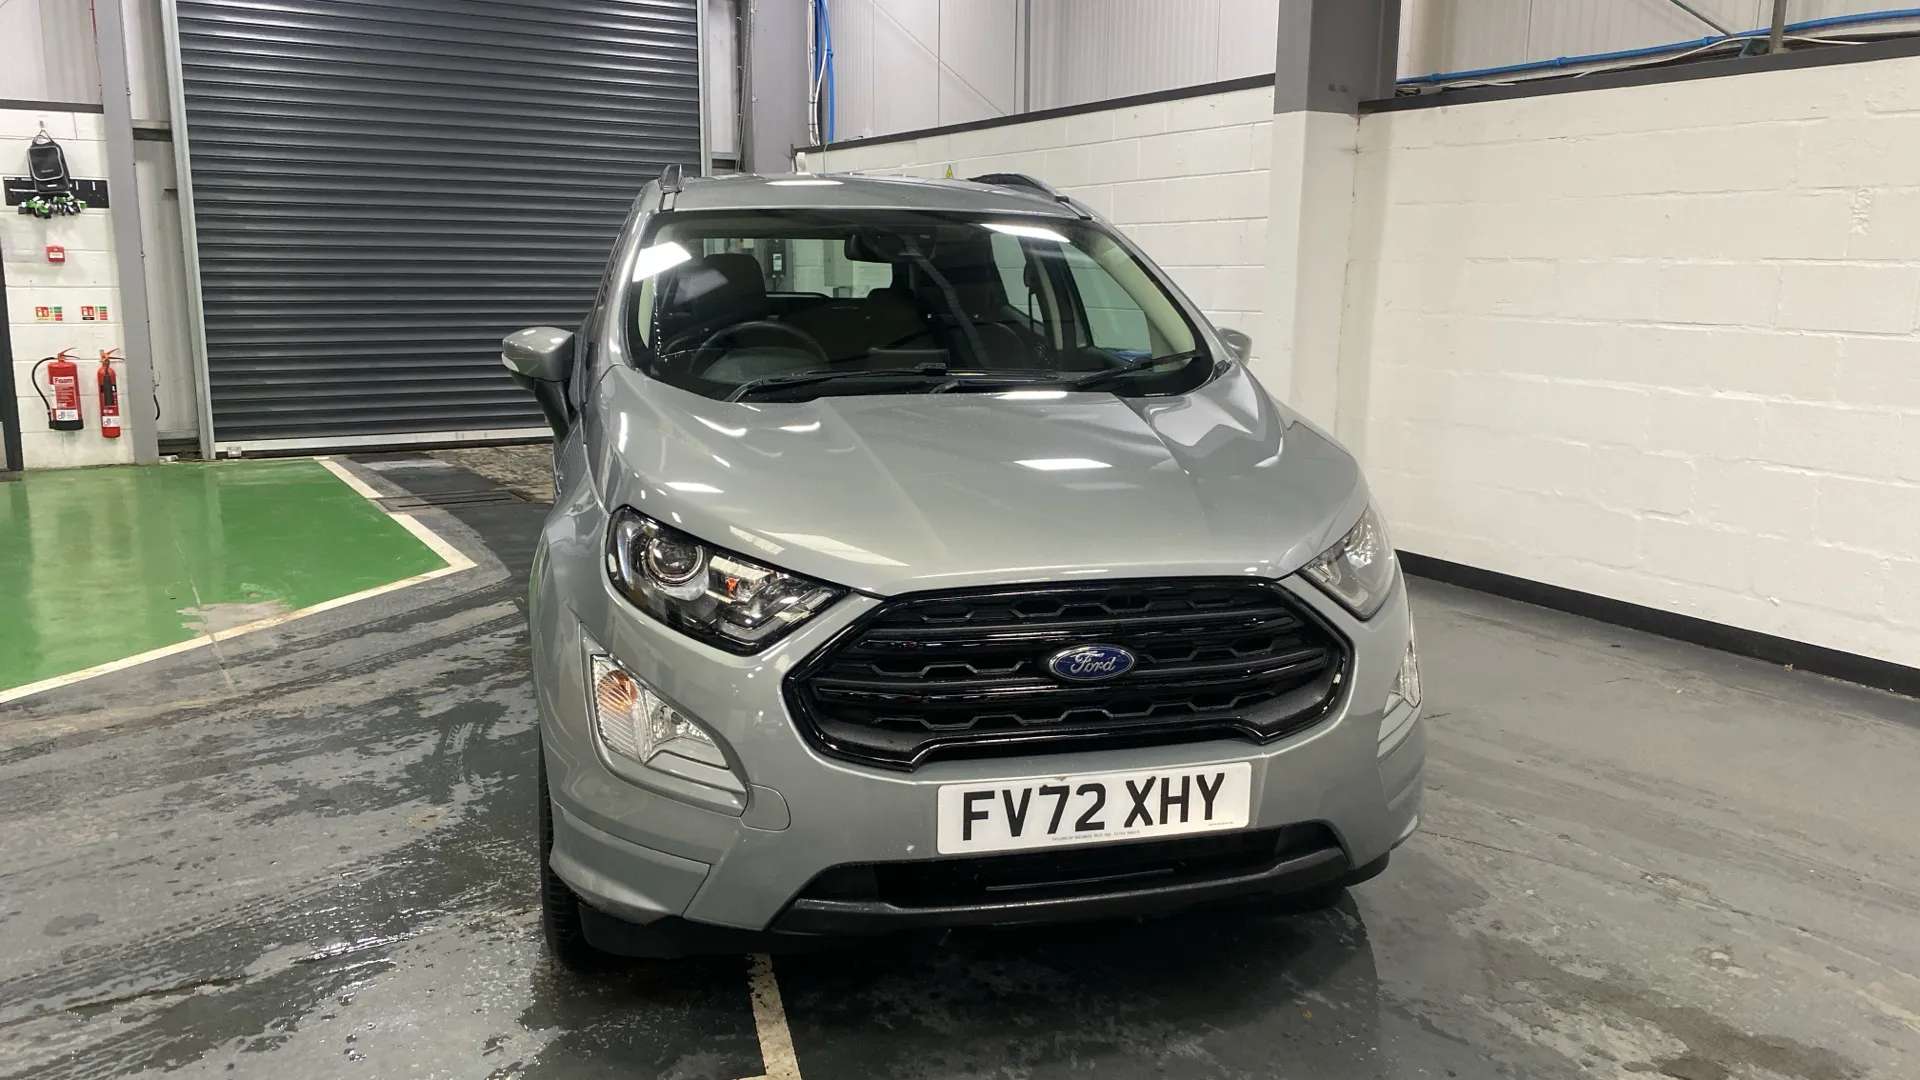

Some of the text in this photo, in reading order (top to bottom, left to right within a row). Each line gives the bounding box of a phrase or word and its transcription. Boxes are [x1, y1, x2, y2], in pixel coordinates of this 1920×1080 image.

[1070, 651, 1116, 673] Ford
[962, 773, 1225, 841] FV72 XHY
